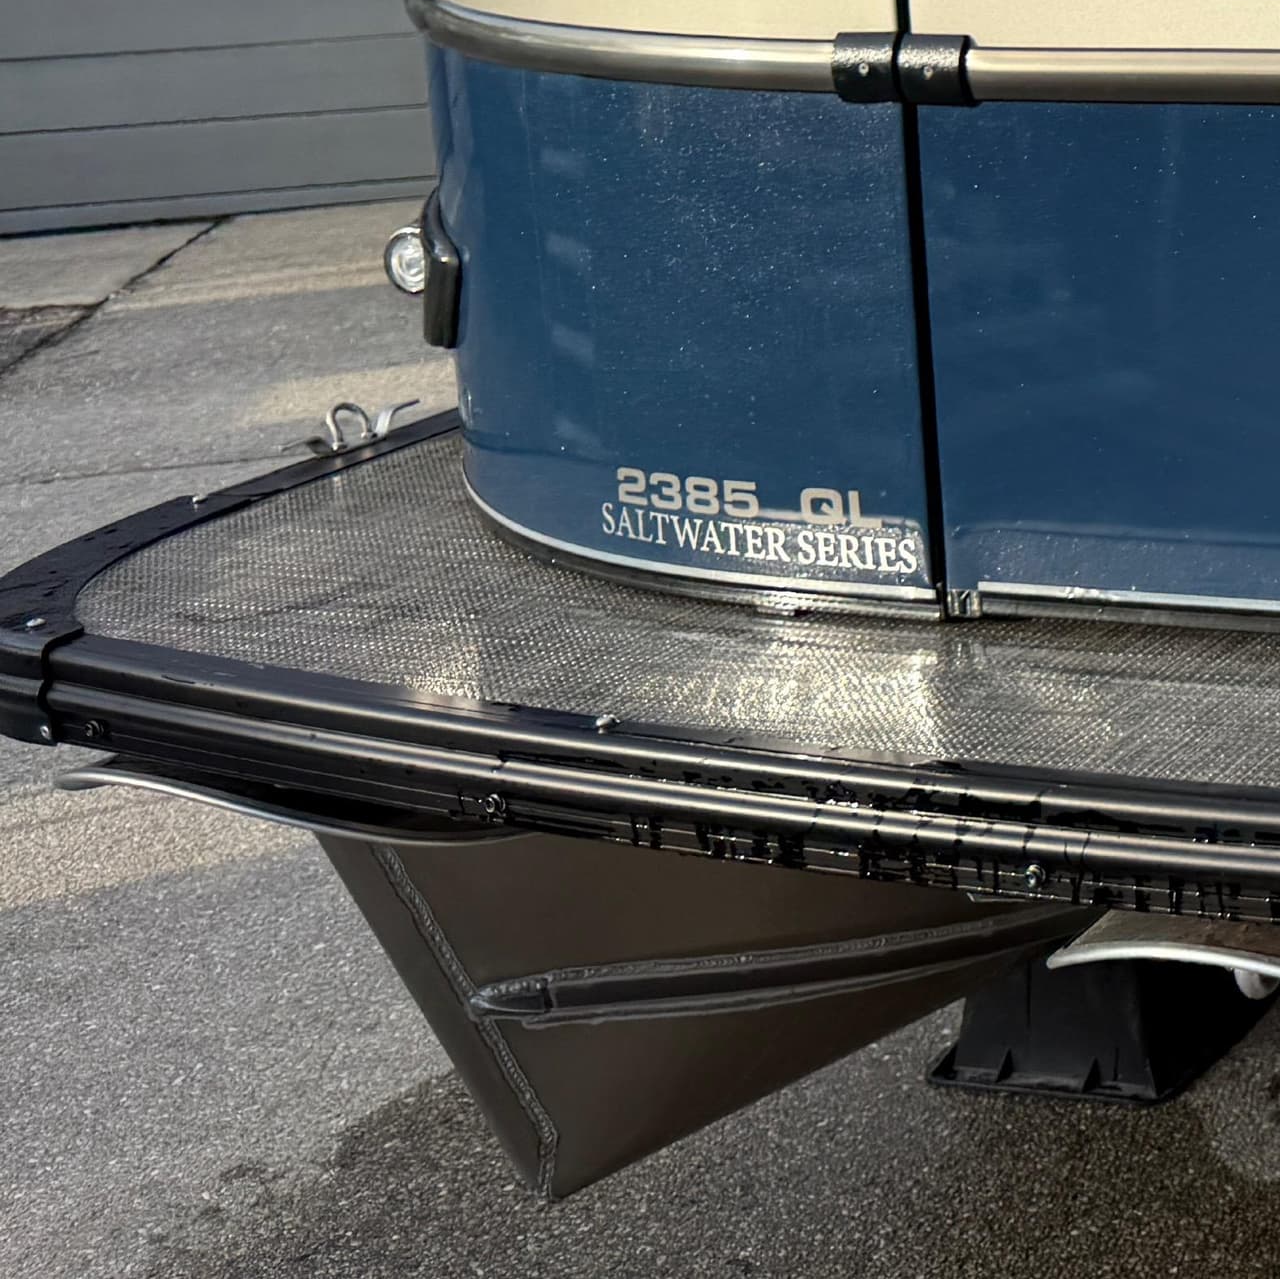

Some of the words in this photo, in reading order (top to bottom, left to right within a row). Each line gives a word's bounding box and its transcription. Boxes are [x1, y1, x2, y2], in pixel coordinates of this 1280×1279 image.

[616, 467, 760, 518] 2385
[800, 487, 883, 528] QL
[601, 502, 790, 563] SALTWATER
[797, 530, 918, 574] SERIES
